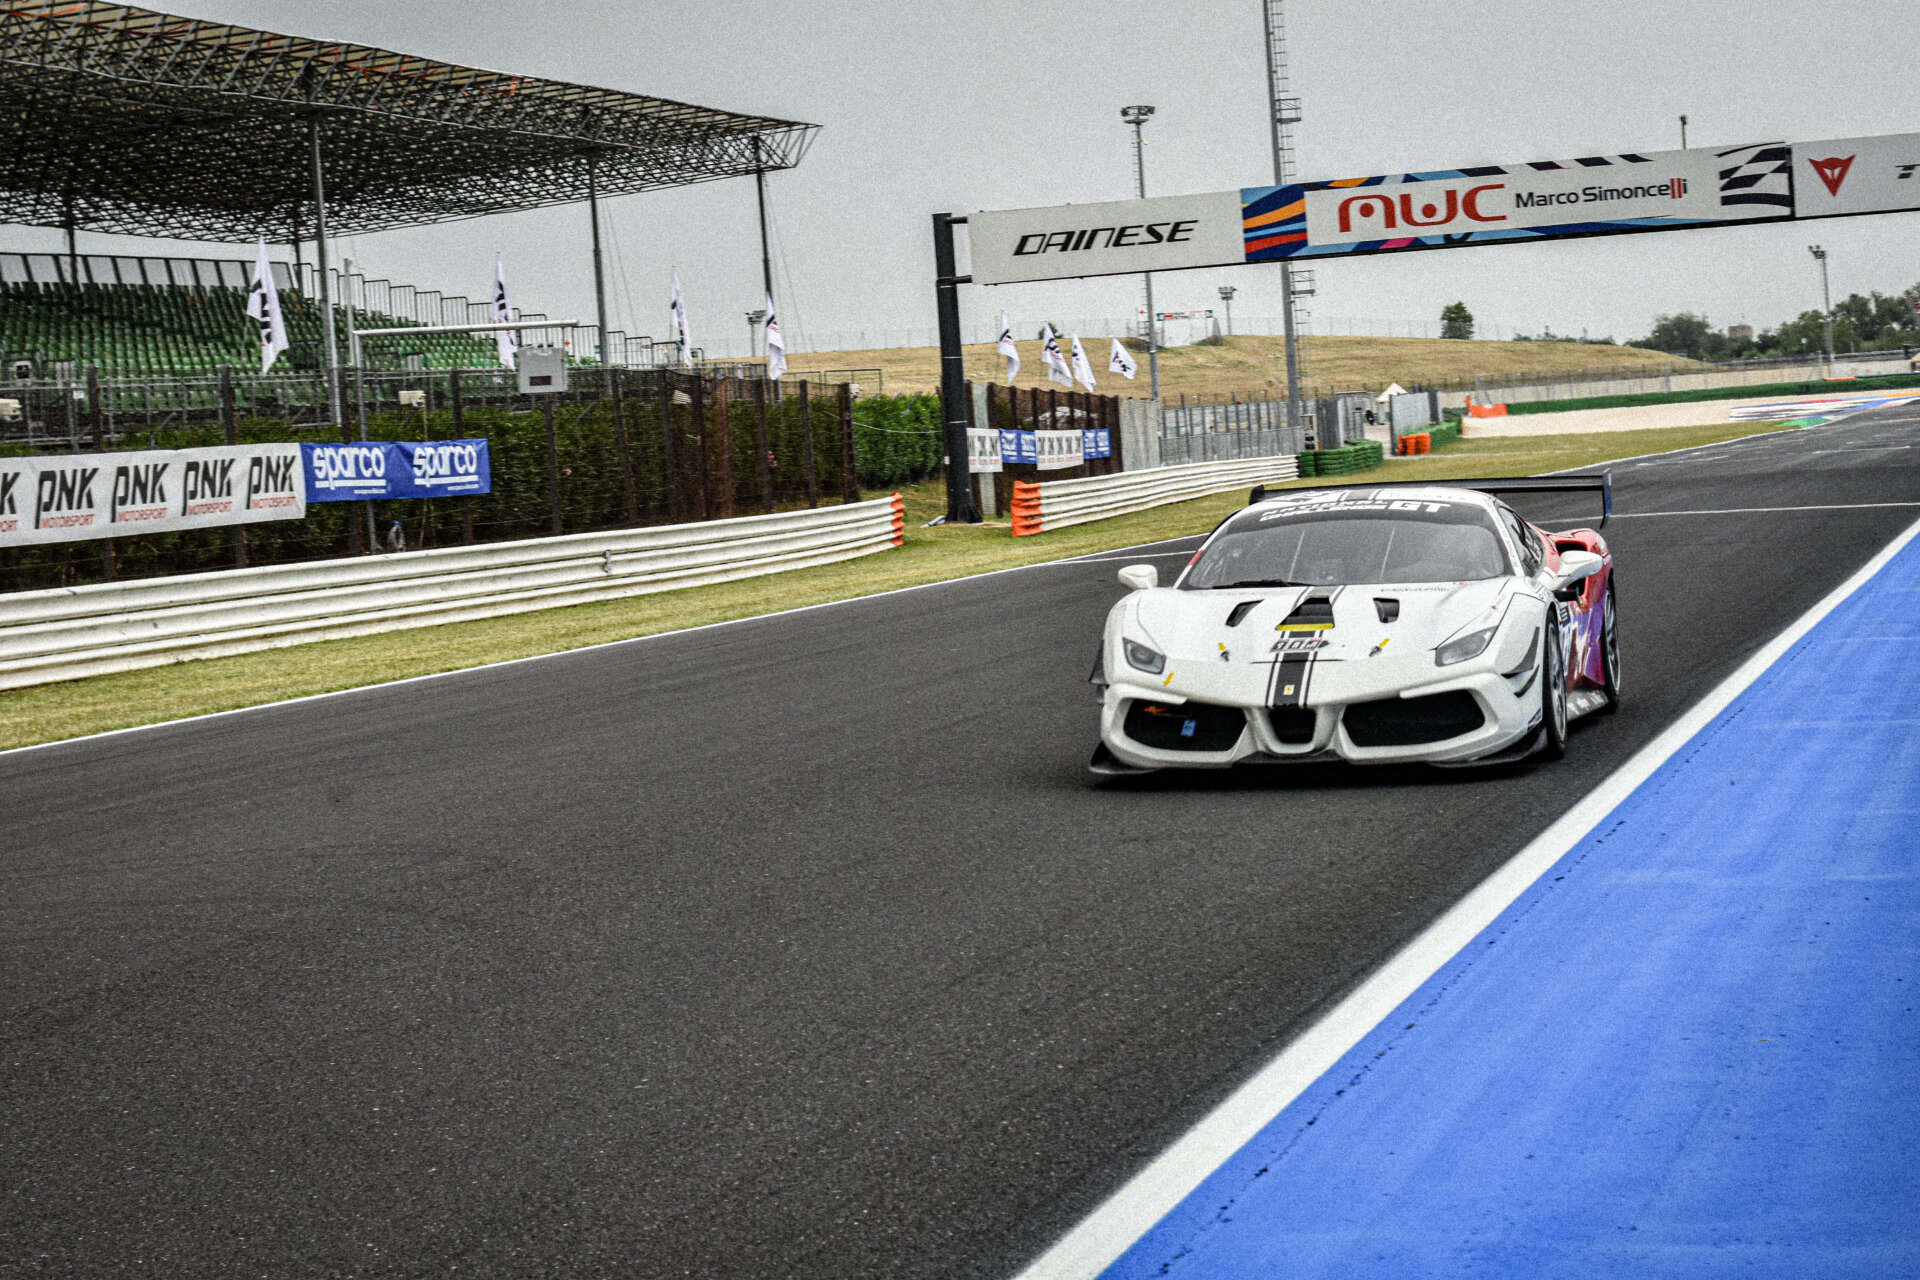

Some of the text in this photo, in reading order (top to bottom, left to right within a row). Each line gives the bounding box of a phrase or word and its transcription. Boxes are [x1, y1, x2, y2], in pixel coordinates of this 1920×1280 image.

[1515, 177, 1688, 209] Marco Simoncelli
[1012, 219, 1199, 256] DAINESE
[181, 458, 236, 517] PNK
[245, 455, 297, 510] PNK
[312, 447, 386, 490] sparco
[412, 445, 478, 487] sparco
[34, 467, 100, 529] PNK
[110, 463, 171, 523] PNK
[1388, 501, 1451, 513] GT
